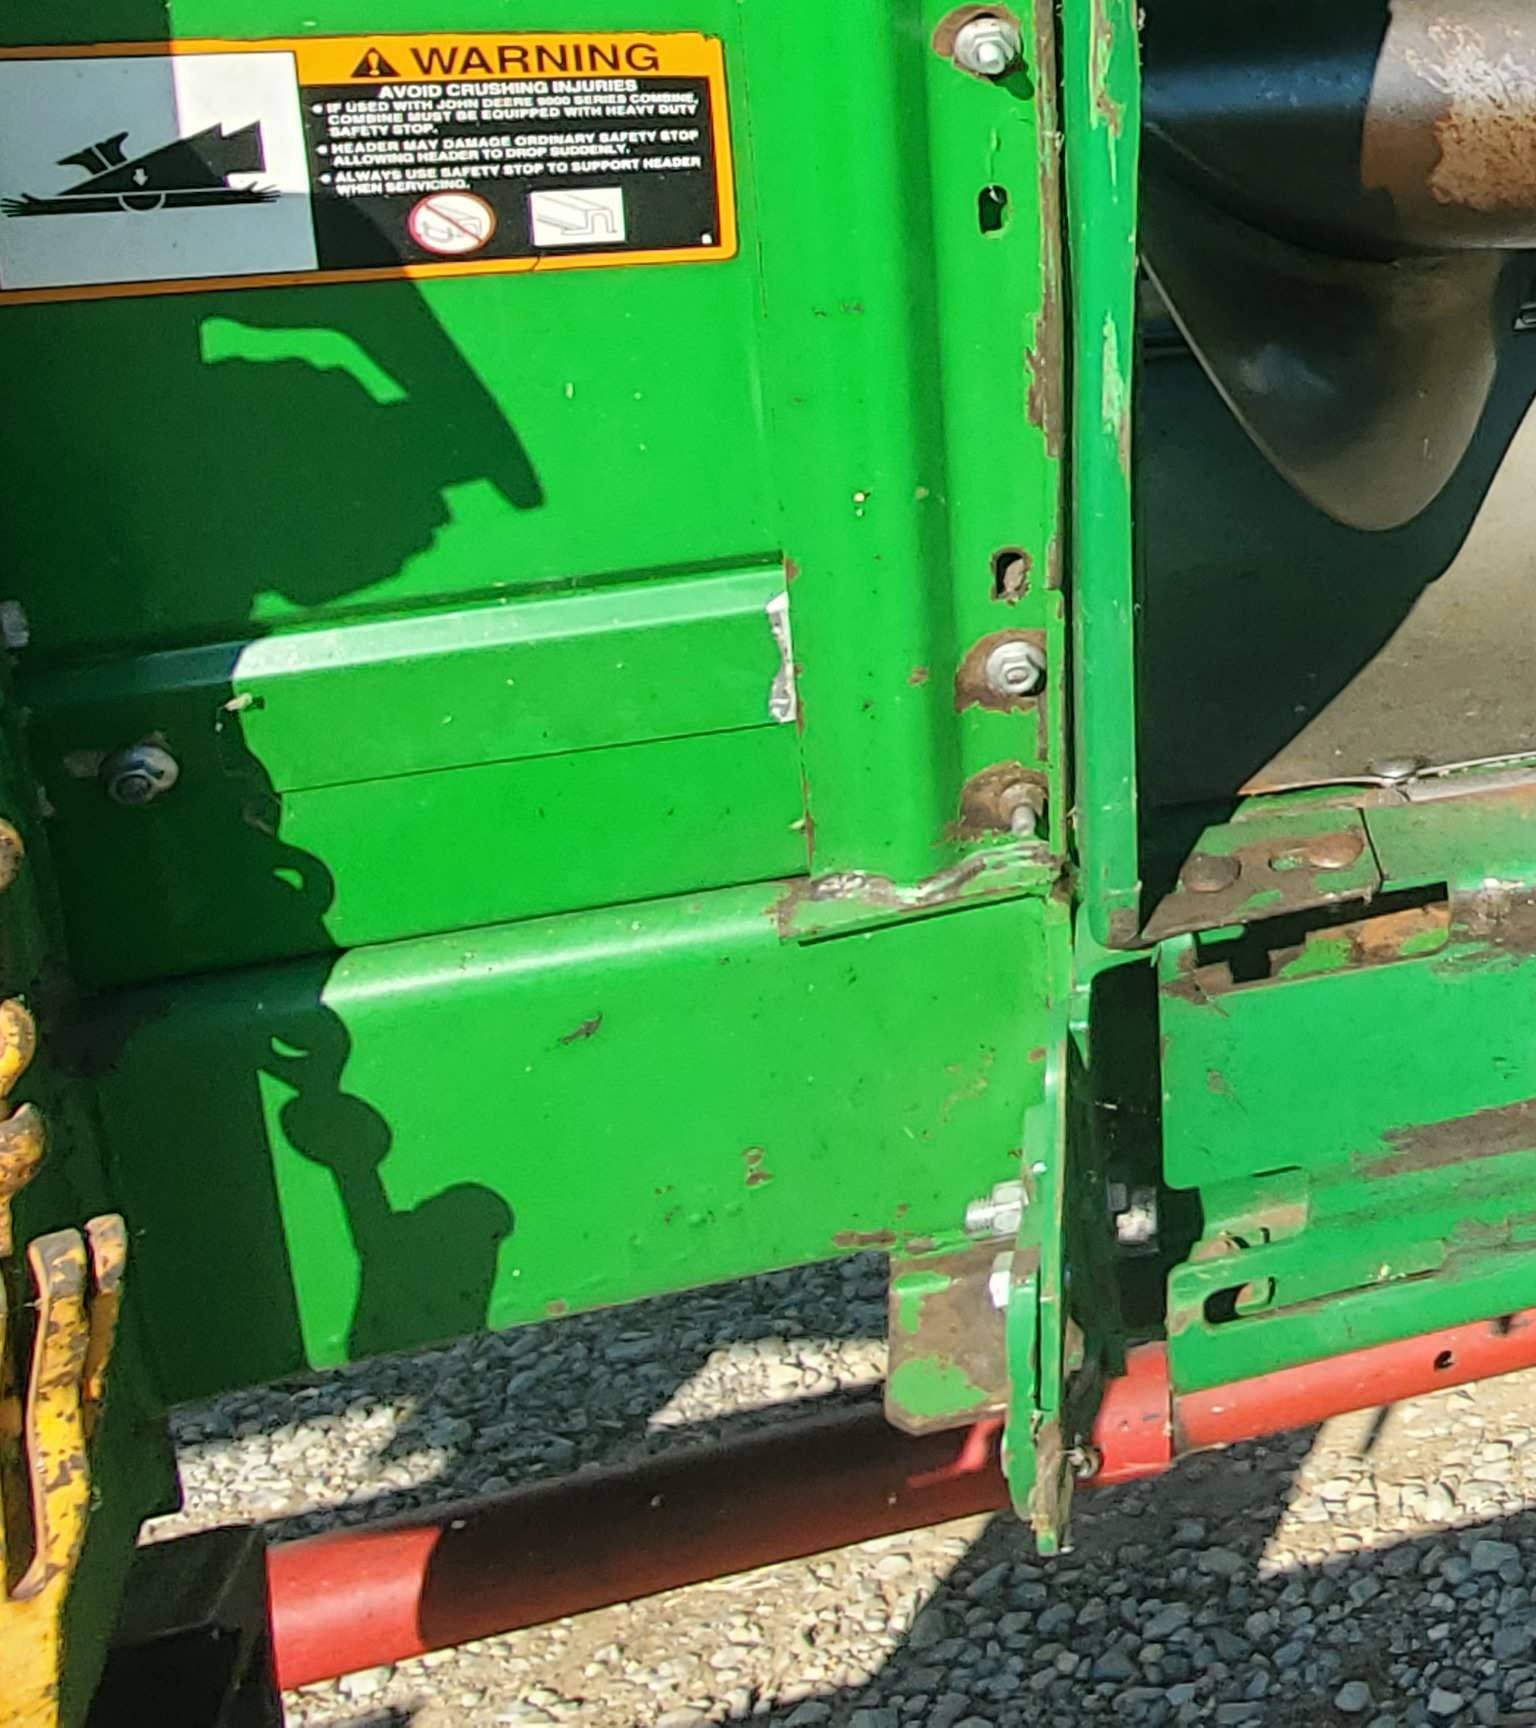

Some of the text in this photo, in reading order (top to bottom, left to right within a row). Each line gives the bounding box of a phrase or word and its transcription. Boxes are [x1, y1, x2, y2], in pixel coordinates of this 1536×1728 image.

[410, 43, 659, 75] WARNING
[378, 79, 638, 99] AVOID CRUSHING INJURIES
[327, 103, 697, 125] COMBINE MUST BE EQUIPPED WITH HEAVY DUTY
[345, 101, 389, 112] USED
[392, 100, 433, 111] WITH
[436, 99, 479, 110] JOHN
[481, 97, 533, 108] DEERE
[328, 125, 389, 137] SAFETY
[331, 129, 699, 154] HEADER MAY DAMAGE ORDINARY SAFETY STOP
[333, 152, 415, 166] ALLOWING
[417, 150, 479, 162] HEADER
[481, 148, 503, 160] TO
[505, 147, 547, 159] DROP
[335, 155, 701, 183] ALWAYS USE SAFETY STOP TO SUPPORT HEADER
[335, 182, 383, 196] WHEN
